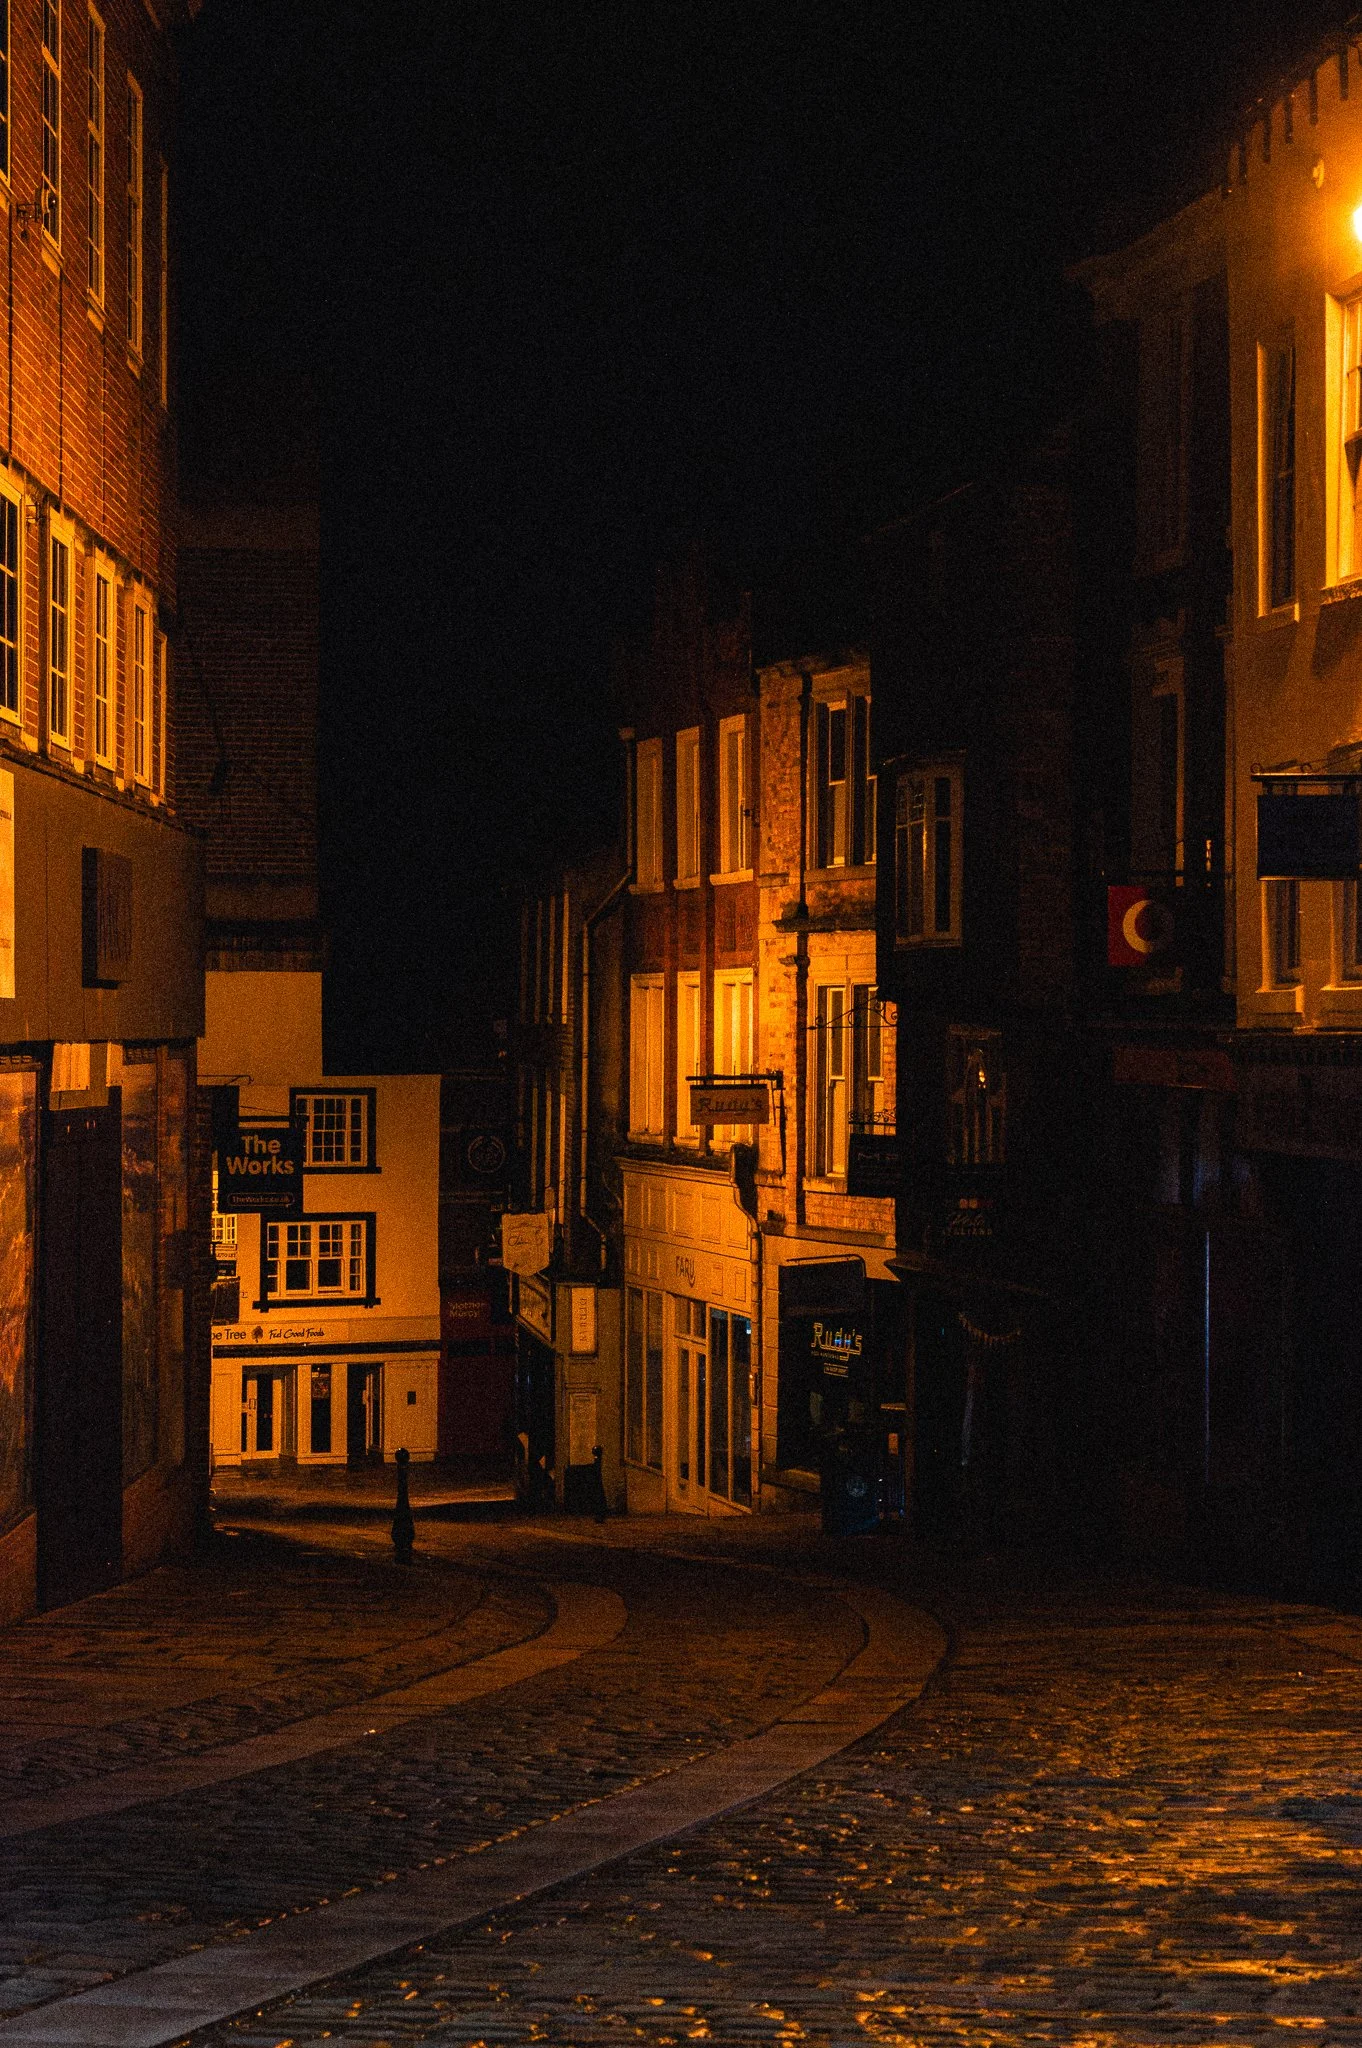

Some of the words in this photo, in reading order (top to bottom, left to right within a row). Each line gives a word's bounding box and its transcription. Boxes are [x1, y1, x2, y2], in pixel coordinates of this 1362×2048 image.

[696, 1097, 764, 1117] Rudy's
[241, 1134, 282, 1155] The
[226, 1155, 296, 1176] Works
[224, 1328, 247, 1341] Tree
[284, 1328, 305, 1340] Good
[306, 1326, 325, 1339] Foods
[810, 1321, 864, 1363] Rudy's
